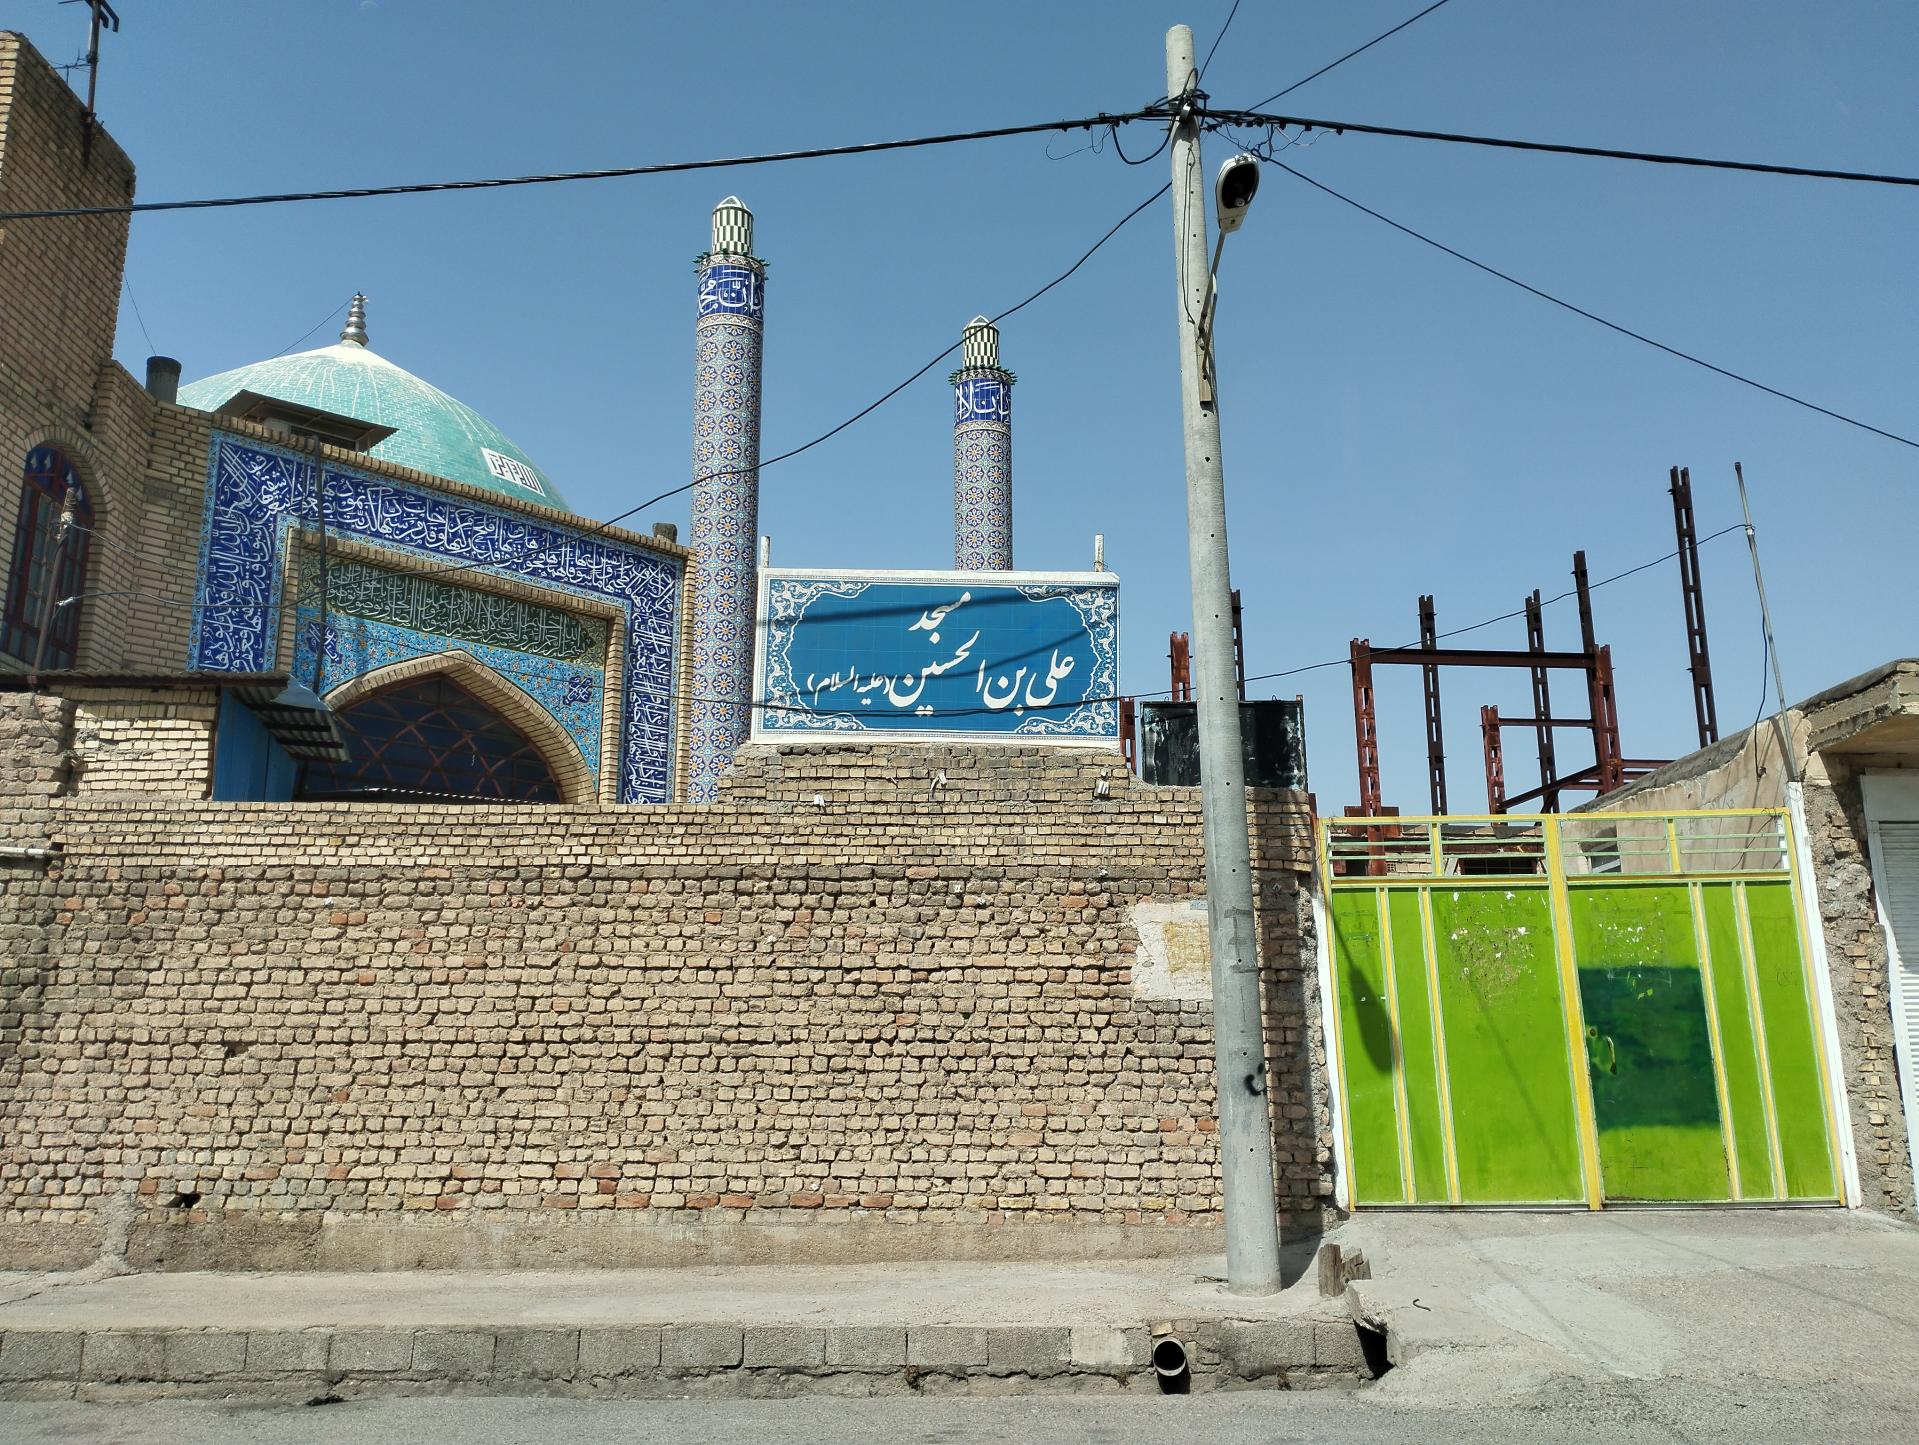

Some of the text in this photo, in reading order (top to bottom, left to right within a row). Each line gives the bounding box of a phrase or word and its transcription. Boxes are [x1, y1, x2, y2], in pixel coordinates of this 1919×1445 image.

[908, 591, 972, 644] مسجد
[887, 630, 986, 716] الحسین
[983, 666, 1027, 716] بن
[1025, 648, 1075, 707] علی
